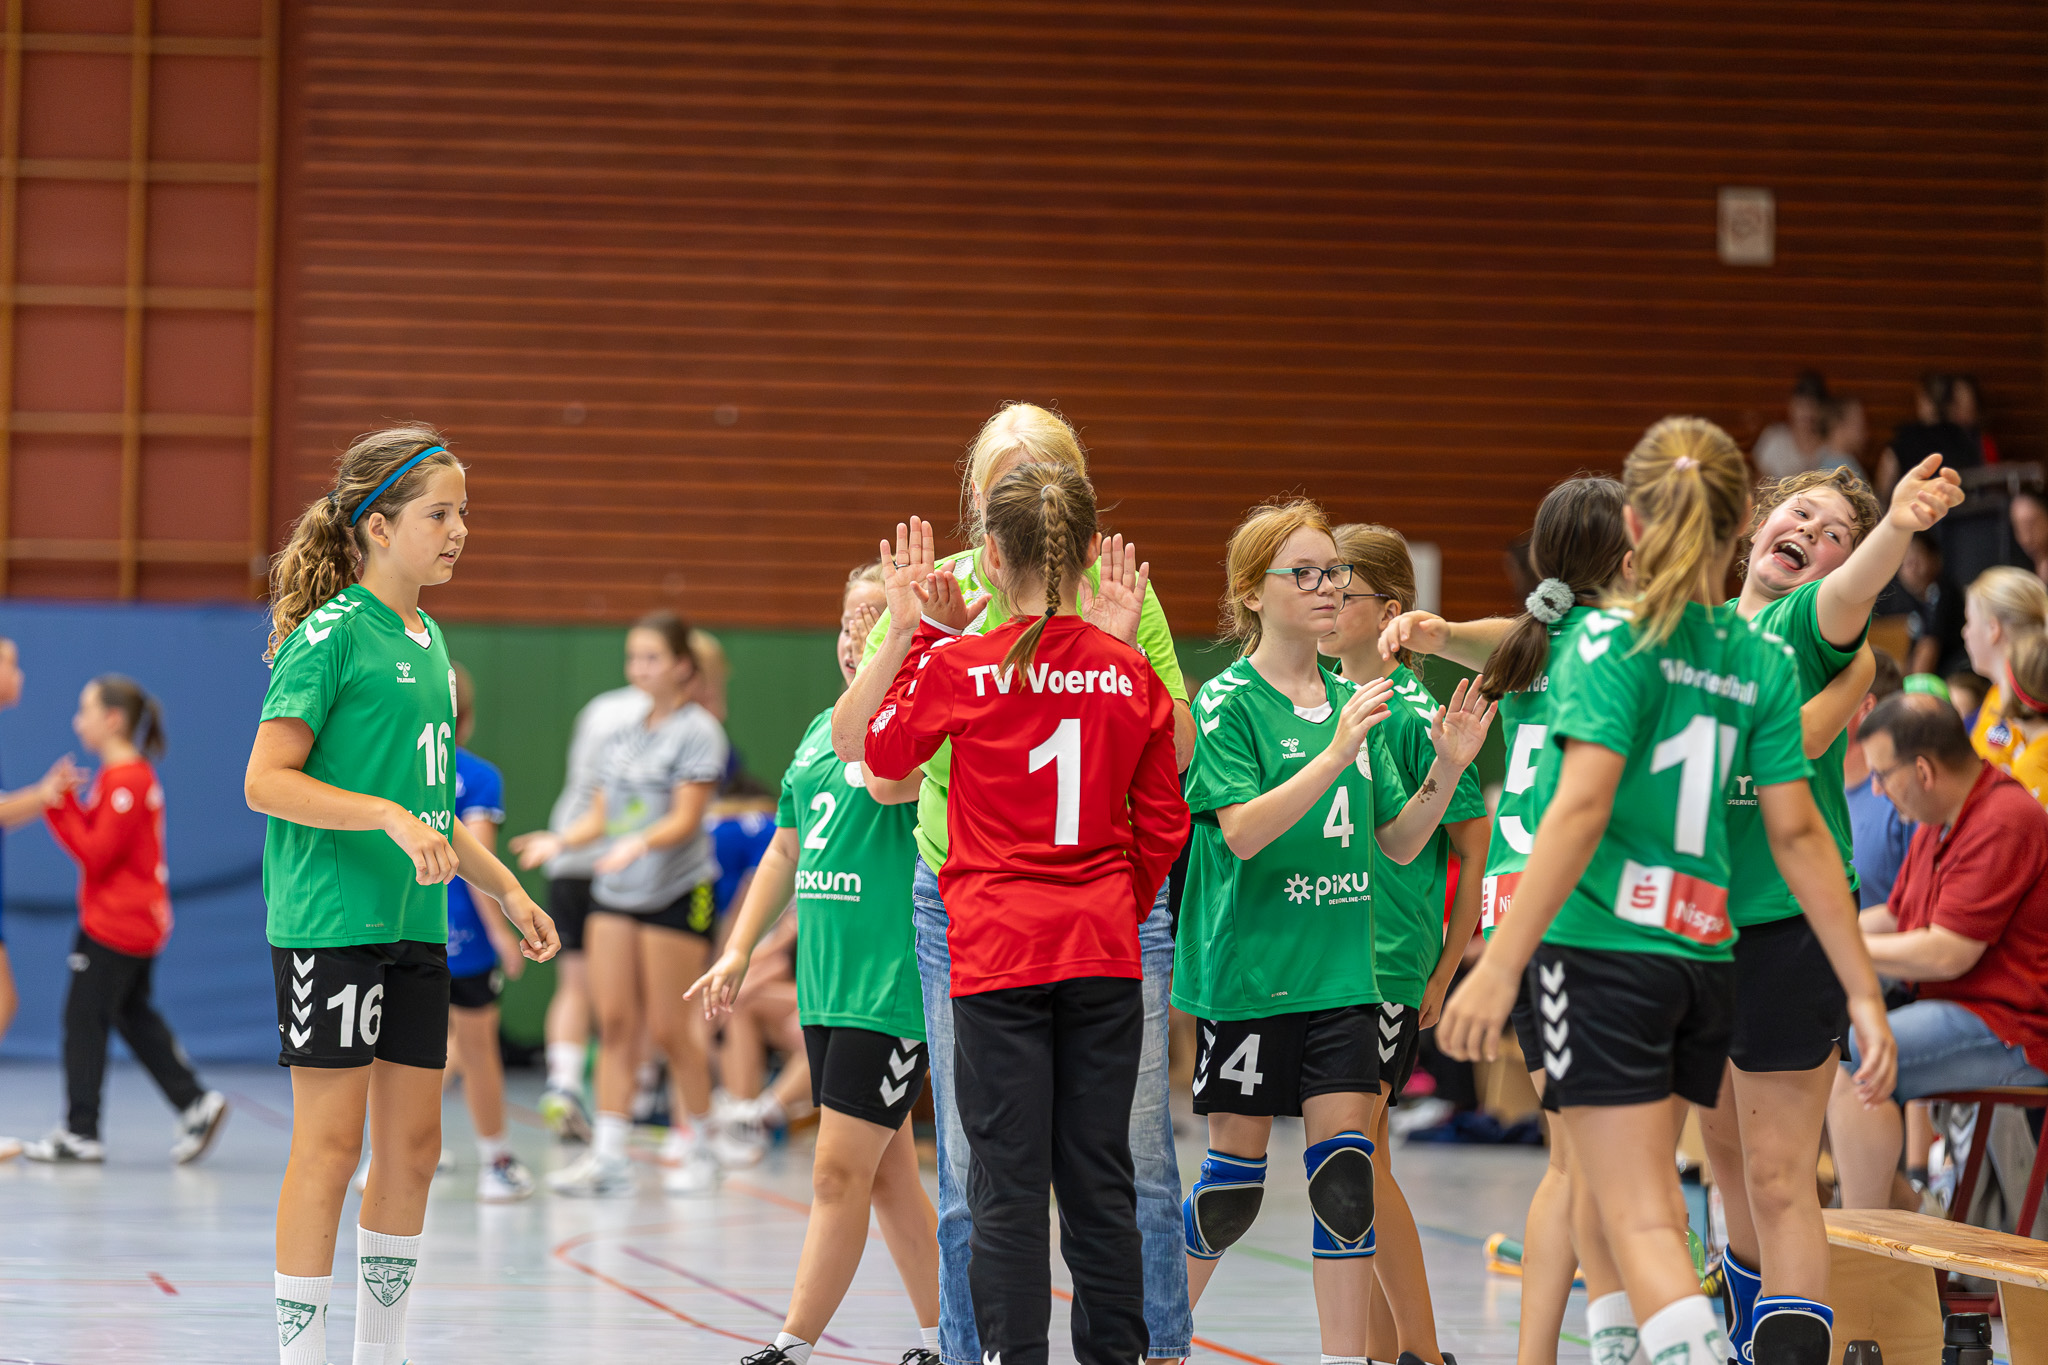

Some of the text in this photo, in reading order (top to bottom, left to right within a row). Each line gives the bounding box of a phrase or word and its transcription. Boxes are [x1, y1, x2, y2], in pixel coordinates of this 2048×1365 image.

[967, 663, 1133, 697] TV Voerde
[417, 721, 451, 787] 16
[1028, 718, 1081, 846] 1
[803, 791, 837, 850] 2
[1323, 785, 1355, 849] 4
[1499, 723, 1548, 855] 5
[1315, 871, 1369, 907] pixu
[326, 983, 385, 1048] 16
[1219, 1033, 1264, 1096] 4
